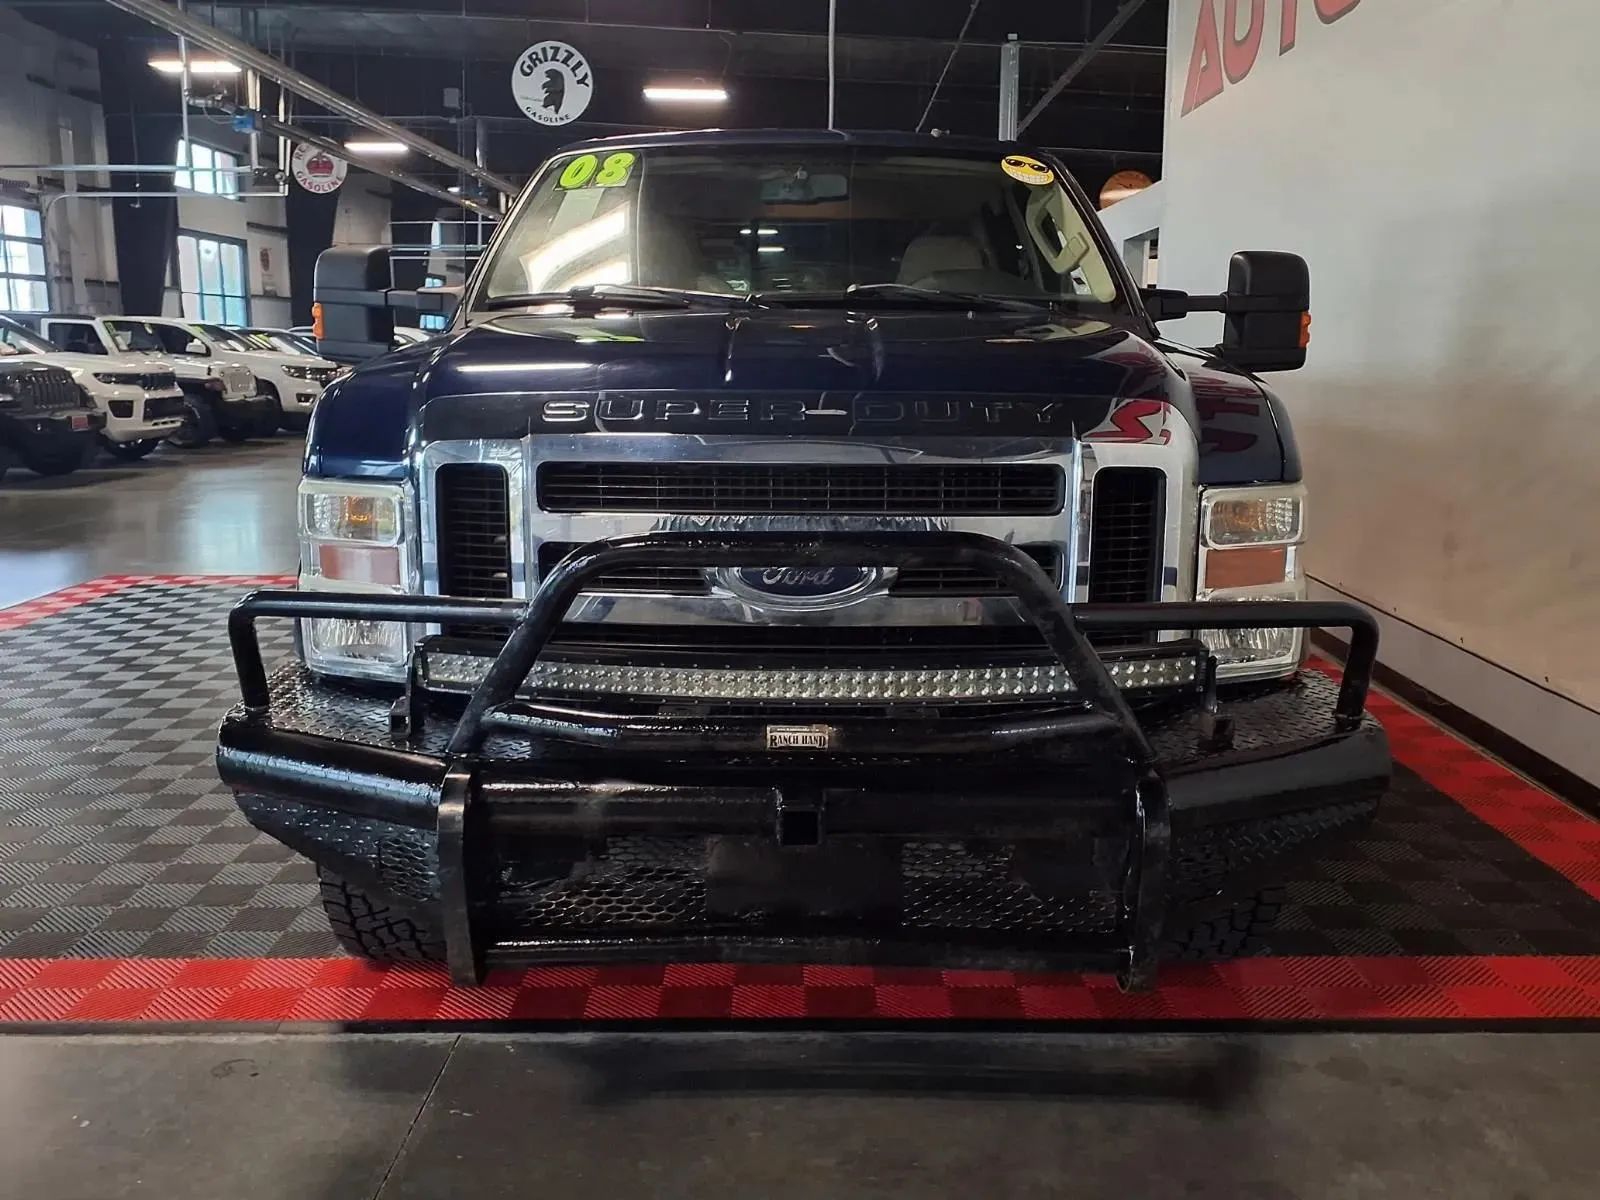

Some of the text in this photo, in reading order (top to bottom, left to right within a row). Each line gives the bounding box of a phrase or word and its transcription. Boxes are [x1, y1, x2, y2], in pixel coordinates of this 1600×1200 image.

[519, 46, 589, 88] GRIZZLY
[526, 106, 571, 123] GASOLINE
[296, 170, 345, 192] GASOLINE
[559, 152, 636, 189] 08
[770, 735, 826, 747] RANCH HAND
